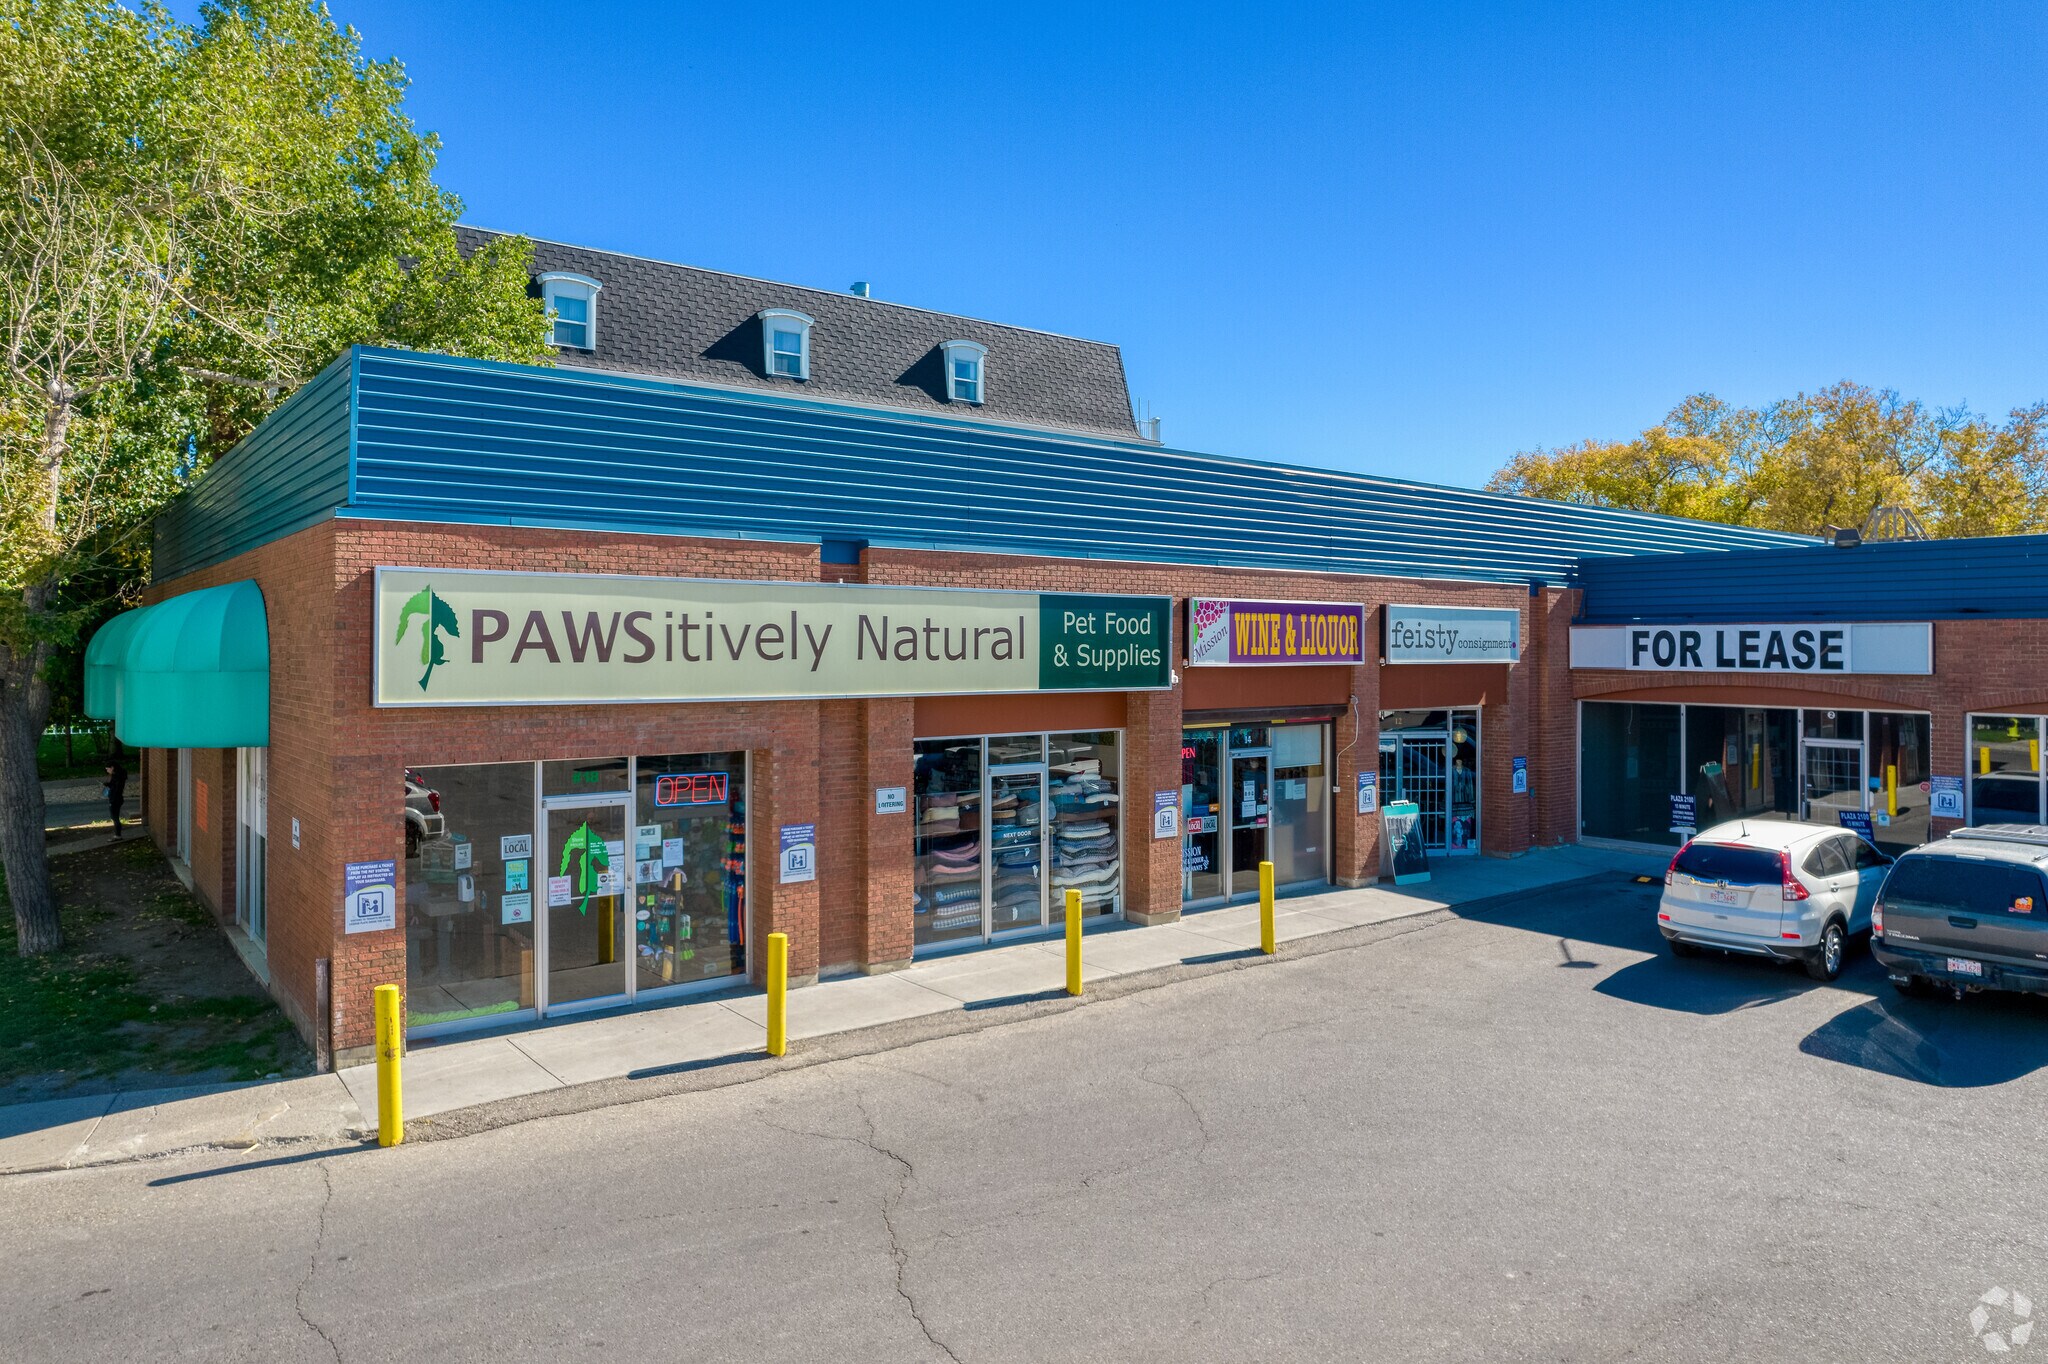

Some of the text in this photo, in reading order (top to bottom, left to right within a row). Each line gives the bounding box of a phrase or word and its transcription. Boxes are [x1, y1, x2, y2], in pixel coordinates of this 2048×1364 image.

[1063, 611, 1151, 635] Pet Food
[471, 609, 1026, 671] PAWSitively Natural
[1234, 613, 1359, 656] WINE & LIQUOR
[1391, 621, 1459, 655] feisty
[1194, 626, 1228, 662] Mission
[1632, 630, 1844, 670] FOR LEASE
[1053, 643, 1161, 672] & Supplies
[1395, 717, 1402, 725] 12
[1181, 747, 1196, 759] PEN
[572, 771, 599, 784] #18
[657, 775, 726, 804] OPEN
[1670, 794, 1683, 802] PLAZA
[878, 801, 904, 809] LOITERING
[1840, 812, 1856, 820] PLAZA
[504, 843, 529, 854] LOCAL
[1182, 846, 1202, 857] ISSION
